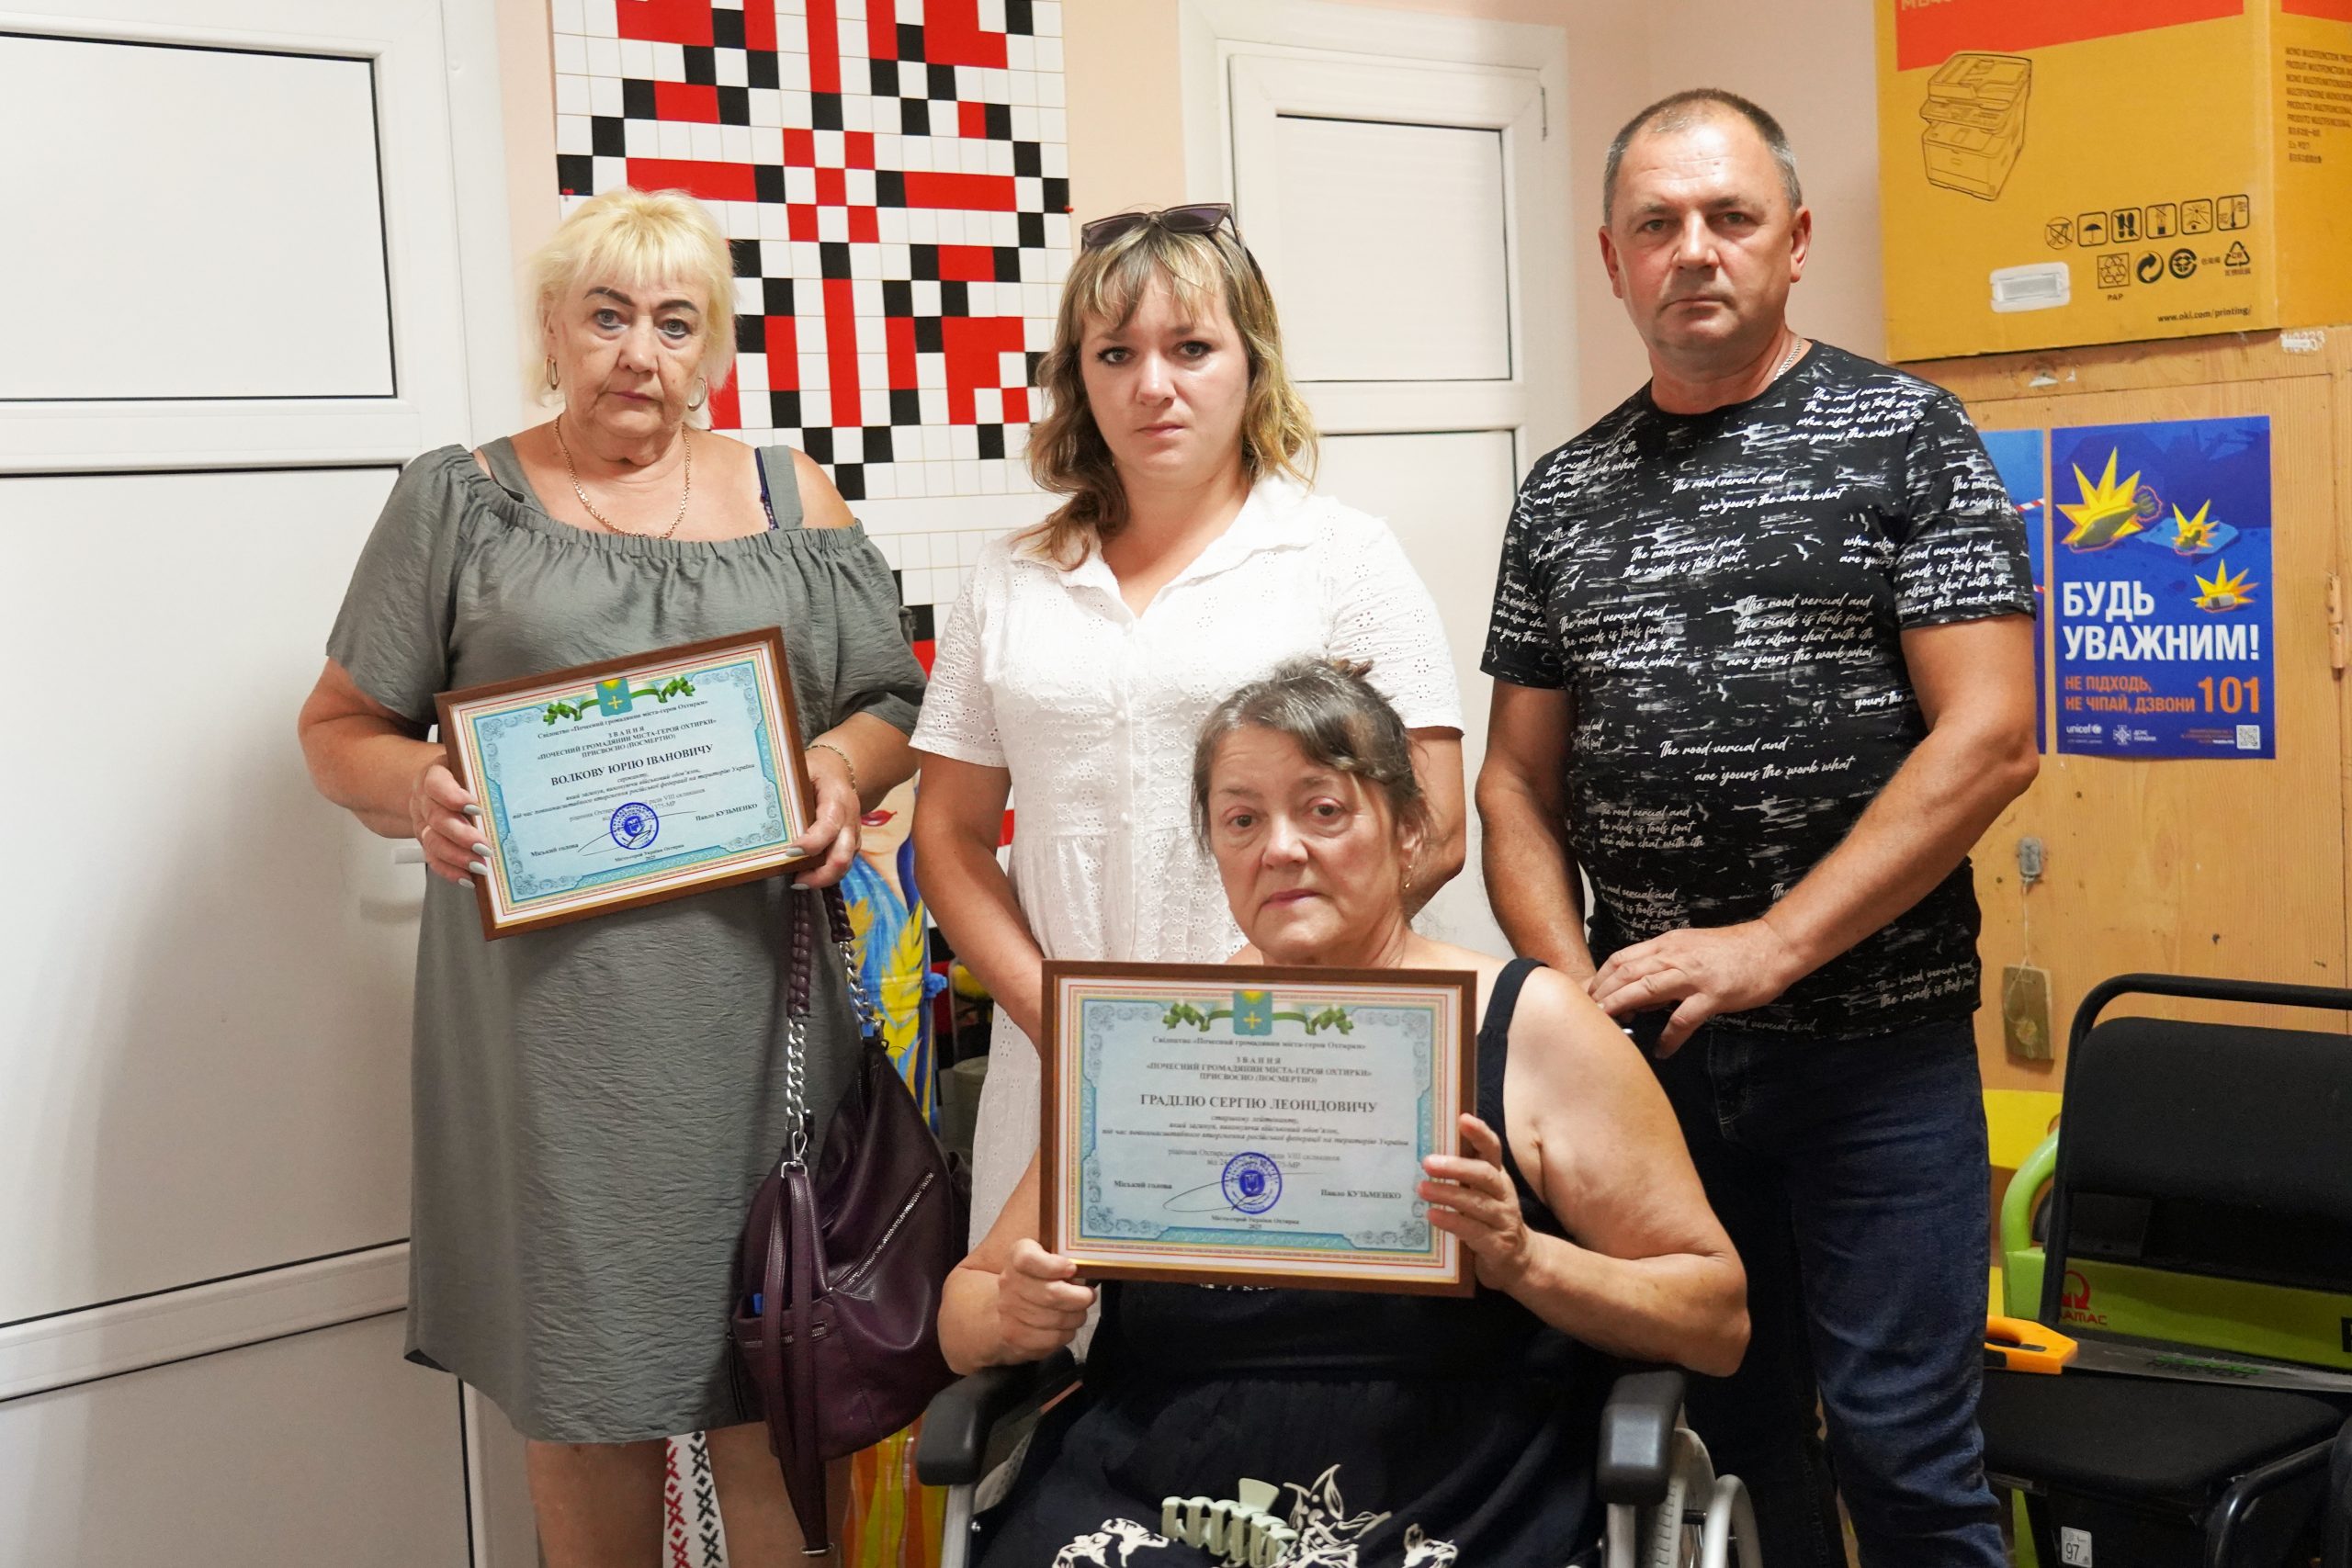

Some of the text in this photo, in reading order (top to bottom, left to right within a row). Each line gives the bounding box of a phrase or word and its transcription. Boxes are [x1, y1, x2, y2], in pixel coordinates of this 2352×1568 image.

[2158, 306, 2252, 321] www.oki.com/printing/
[1813, 487, 1848, 500] what
[1849, 594, 1873, 608] and
[2064, 581, 2154, 623] БУДЬ
[1643, 604, 1668, 617] and
[1802, 615, 1815, 626] is
[1817, 611, 1843, 625] tools
[1620, 624, 1642, 638] tools
[1801, 626, 1832, 642] chat
[1831, 626, 1856, 640] with
[1634, 639, 1657, 652] with
[2064, 625, 2259, 661] УВАЖНИМ!
[1726, 657, 1749, 666] are
[1751, 654, 1791, 671] yours
[1815, 645, 1845, 660] work
[1849, 645, 1878, 658] what
[2065, 676, 2153, 693] НЕ ПІДХОДЬ,
[2198, 676, 2259, 713] 101
[2065, 696, 2195, 713] НЕ ЧІПАЙ, ДЗВОНИ
[2066, 724, 2091, 733] unicef
[1659, 740, 1679, 758] The
[1761, 737, 1790, 751] and
[551, 767, 605, 786] ВОЛКОВУ
[647, 744, 713, 765] ІВАНОВИЧУ
[1694, 773, 1718, 781] are
[1719, 769, 1759, 786] yours
[1786, 760, 1818, 776] work
[1822, 755, 1855, 772] what
[1140, 1093, 1377, 1113] ГРАДІЛЮ СЕРГІЮ ЛЕОНІДОВИЧУ
[2061, 1310, 2107, 1325] AMAC
[2065, 1542, 2080, 1561] 97
